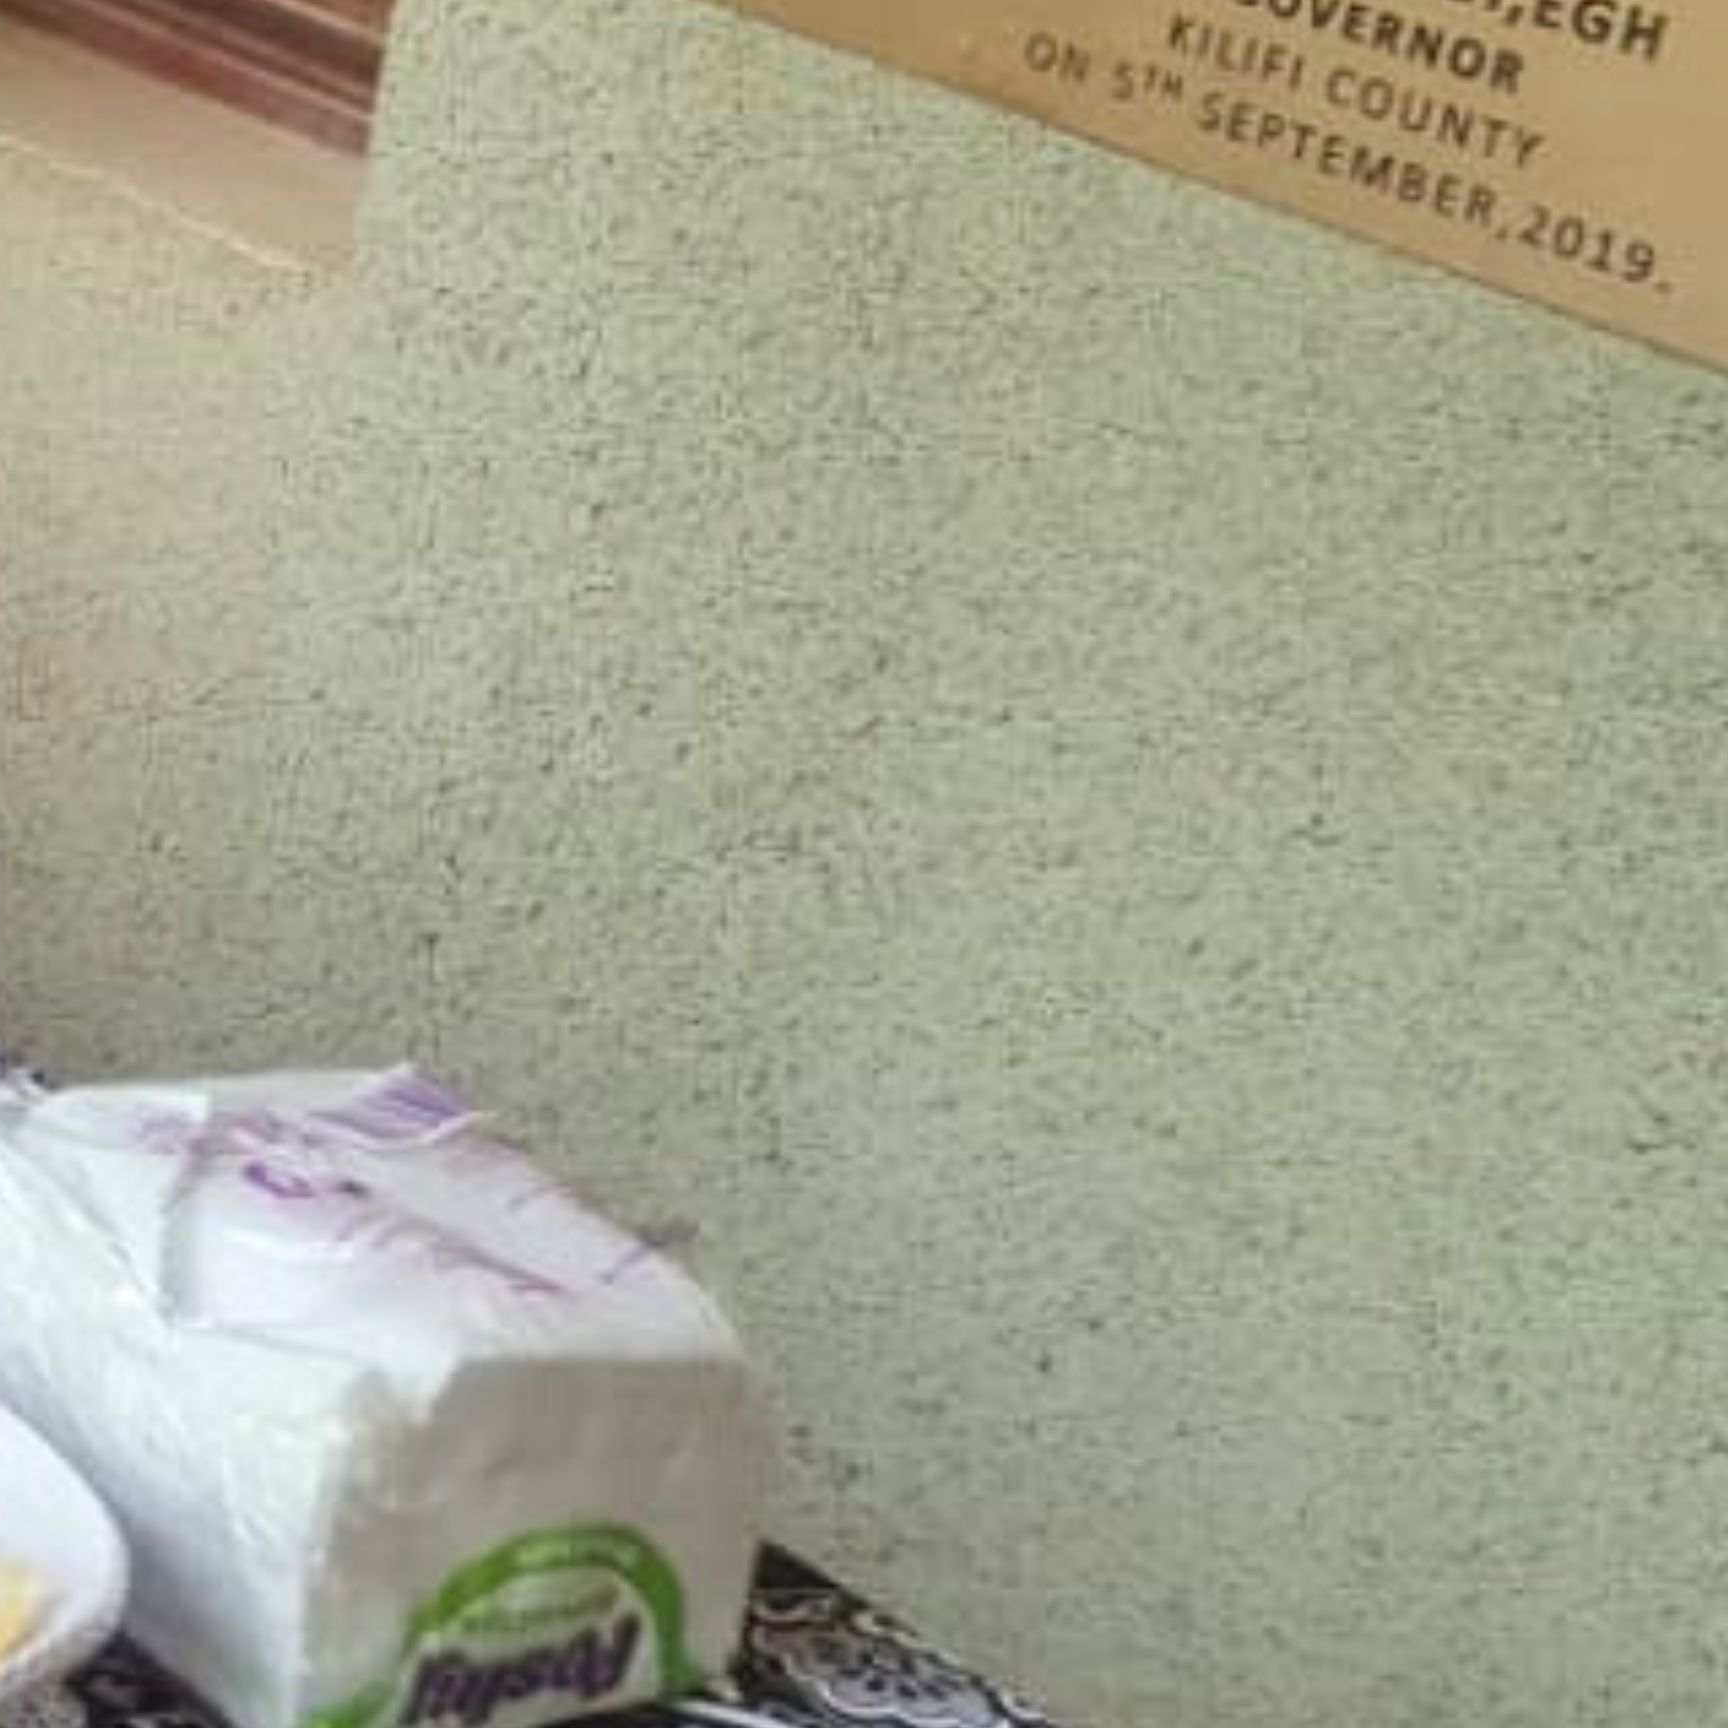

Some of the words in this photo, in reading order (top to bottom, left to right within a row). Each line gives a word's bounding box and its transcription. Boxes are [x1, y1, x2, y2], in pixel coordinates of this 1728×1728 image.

[1024, 31, 1091, 84] ON
[1168, 10, 1307, 92] KILIFI
[1326, 65, 1547, 170] COUNTY
